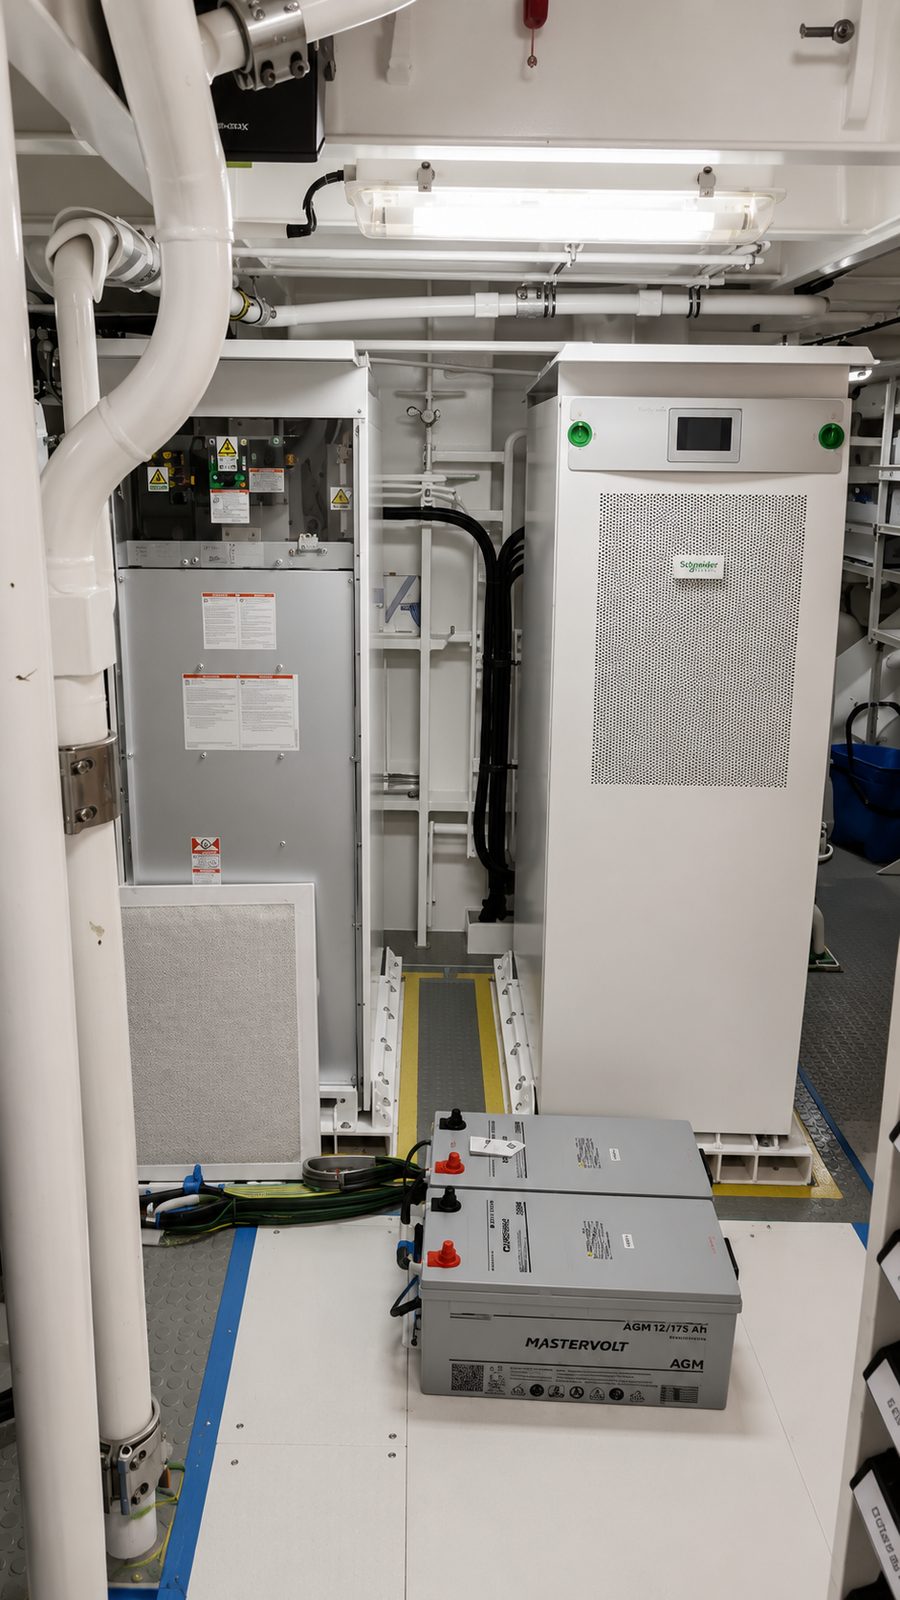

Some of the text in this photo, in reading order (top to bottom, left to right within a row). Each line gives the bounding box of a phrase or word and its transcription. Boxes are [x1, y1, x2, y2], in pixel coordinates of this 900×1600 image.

[680, 560, 718, 572] Schneider
[623, 1322, 707, 1334] AGM 12/175 Ah
[525, 1337, 629, 1352] MASTERVOLT
[670, 1358, 704, 1370] AGM
